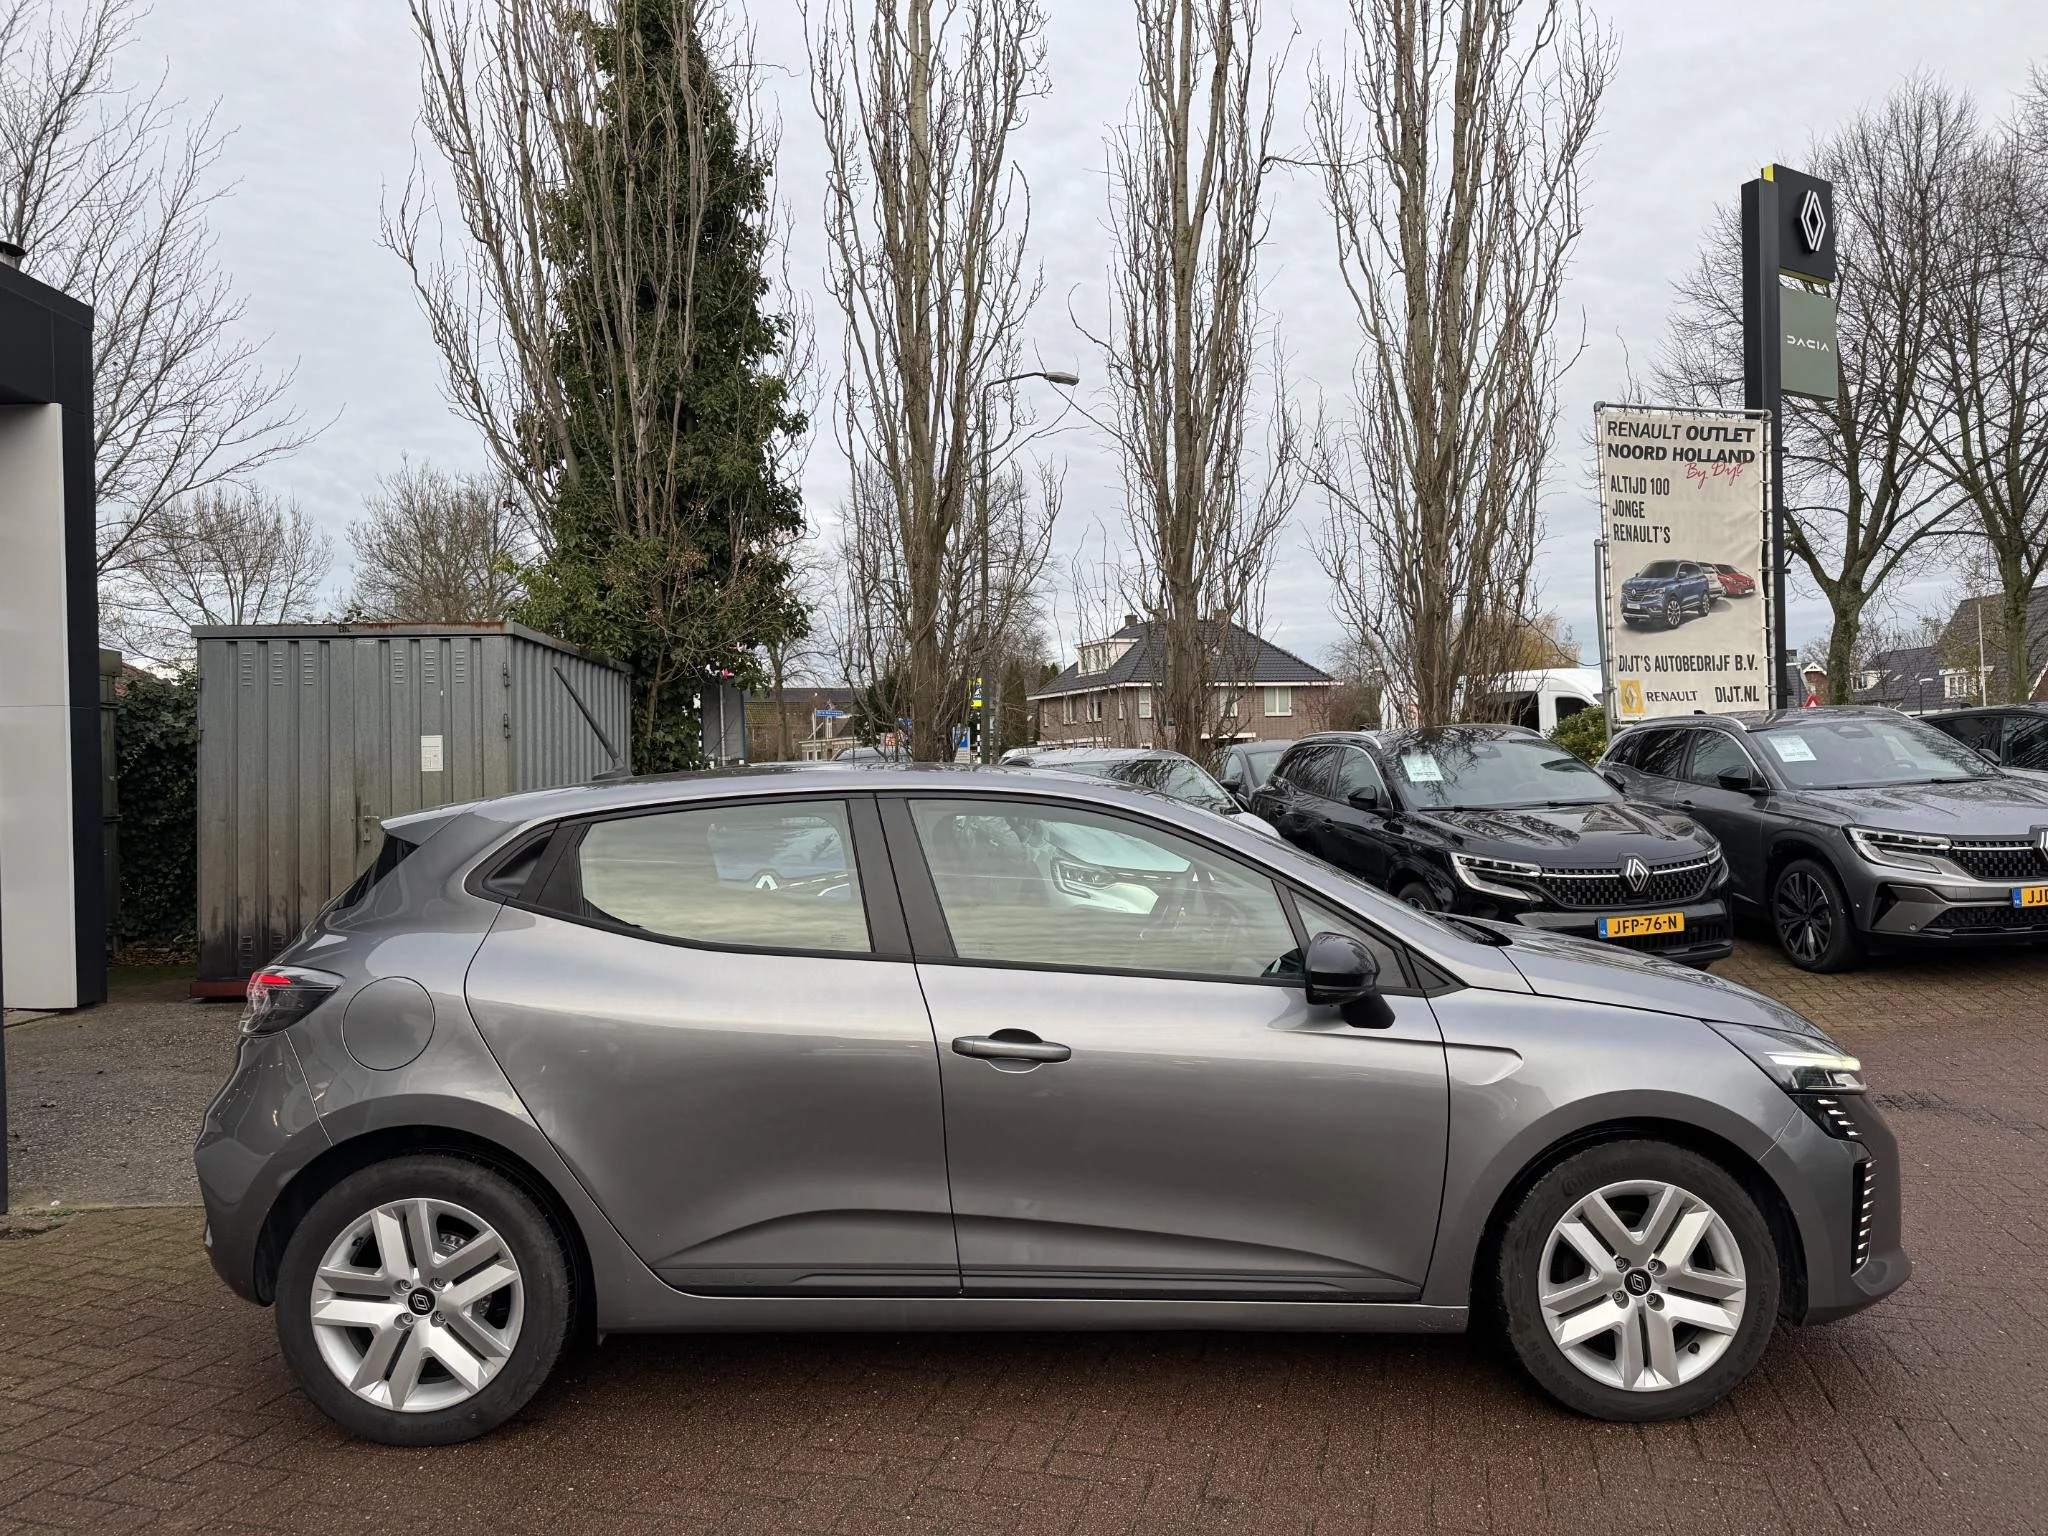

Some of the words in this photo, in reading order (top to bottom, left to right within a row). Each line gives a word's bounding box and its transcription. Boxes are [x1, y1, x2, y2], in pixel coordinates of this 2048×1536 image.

[1786, 334, 1830, 352] DACIA
[1607, 421, 1681, 440] RENAULT
[1685, 425, 1755, 443] OUTLET
[1607, 443, 1667, 461] NOORD
[1672, 447, 1756, 464] HOLLAND
[1610, 475, 1647, 495] ALTIJD
[1650, 478, 1670, 496] 100
[1685, 463, 1707, 490] By
[1612, 499, 1645, 519] JONGE
[1613, 524, 1671, 544] RENAULT'S
[1618, 654, 1651, 672] DIJT'S
[1654, 654, 1730, 672] AUTOBEDRIJF
[1735, 654, 1758, 671] B.V.
[1646, 690, 1698, 702] RENAULT
[1715, 685, 1760, 703] DIJT.NL
[1614, 915, 1677, 934] JFP-76-N
